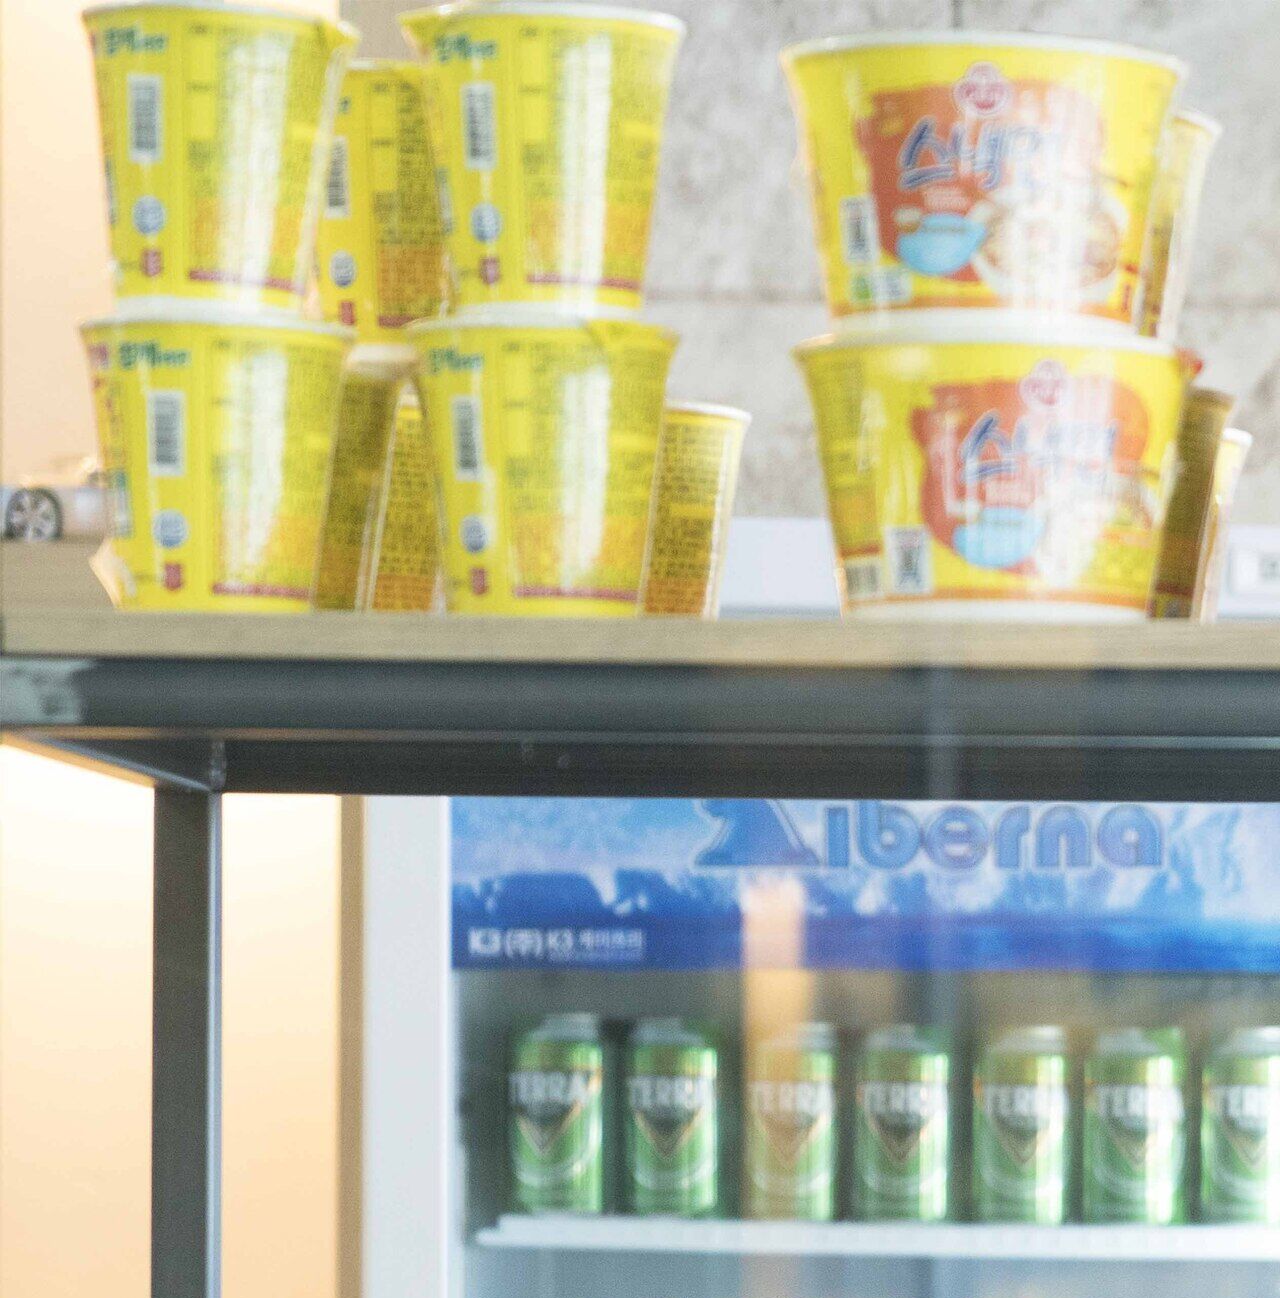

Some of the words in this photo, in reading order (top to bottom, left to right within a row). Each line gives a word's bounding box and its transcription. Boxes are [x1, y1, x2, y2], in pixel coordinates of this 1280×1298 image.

[509, 1070, 590, 1104] TERRA
[628, 1075, 716, 1110] TERRA
[747, 1080, 833, 1114] TERRA
